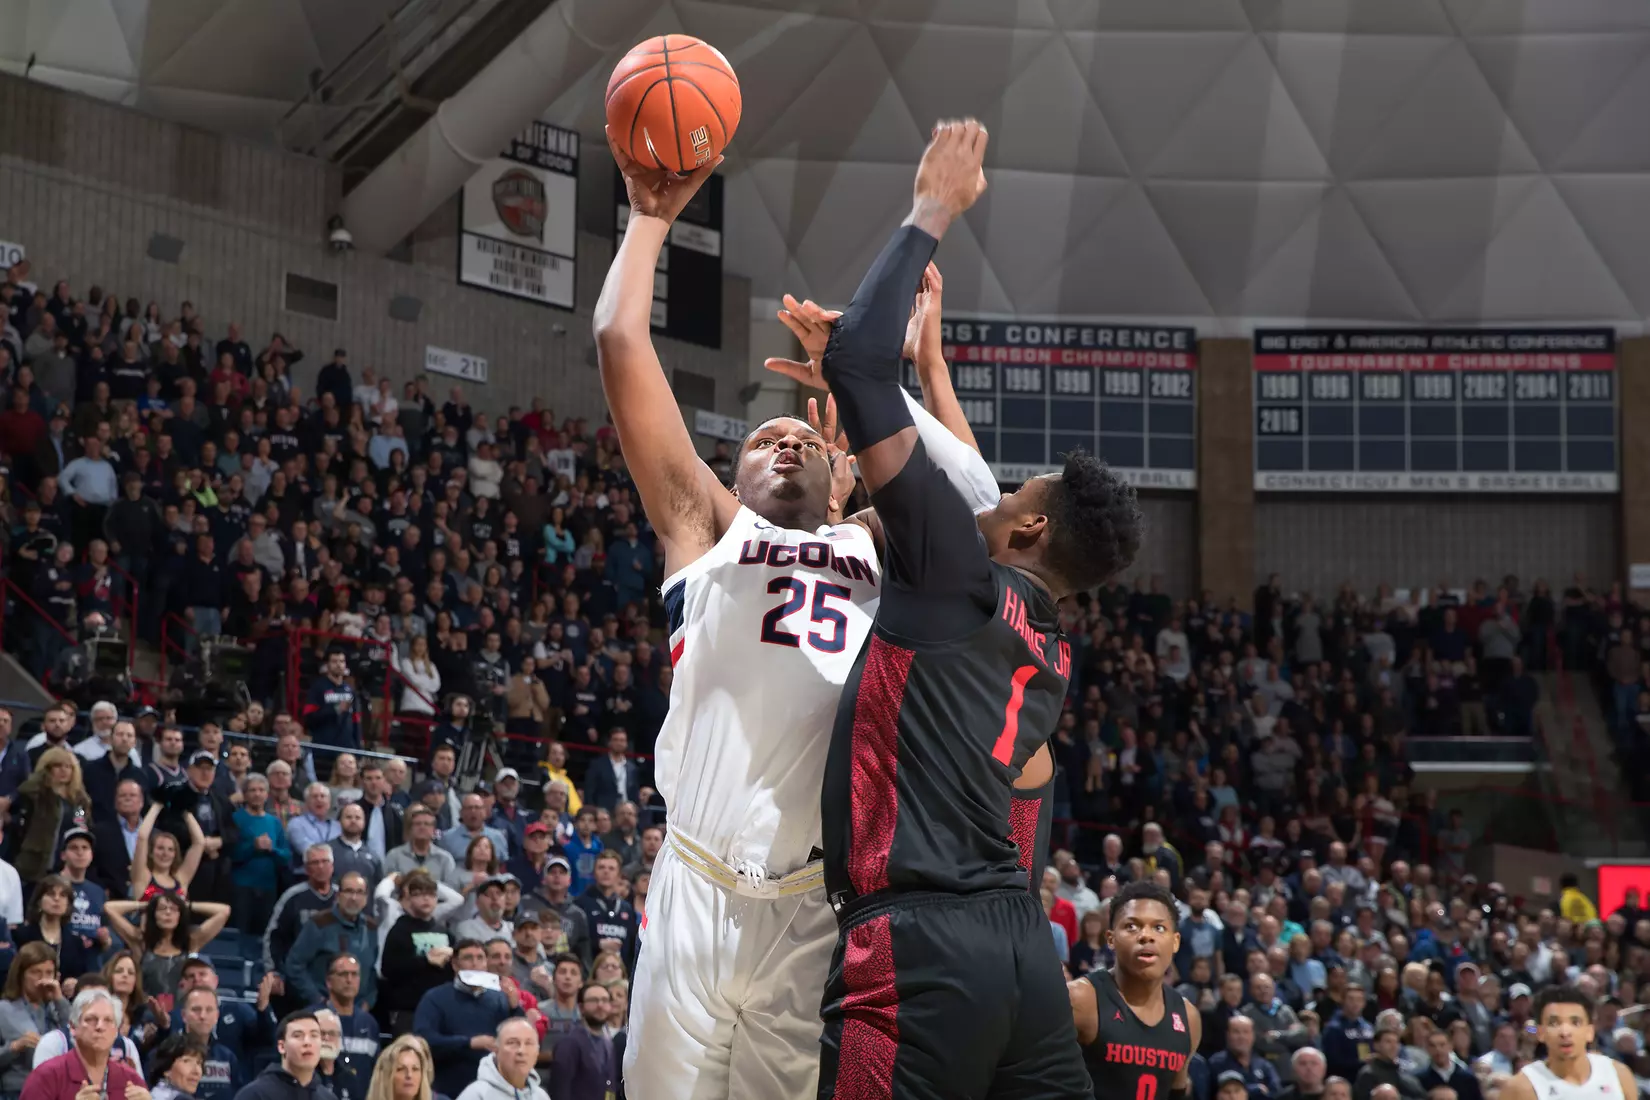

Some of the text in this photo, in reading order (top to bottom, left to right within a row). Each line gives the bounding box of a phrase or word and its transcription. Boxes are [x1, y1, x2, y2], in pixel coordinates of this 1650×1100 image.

[941, 323, 1187, 349] AST CONFERENCE
[1261, 336, 1287, 349] BIG
[1290, 336, 1328, 349] EAST
[1350, 336, 1429, 349] AMERICAN
[1432, 336, 1505, 349] ATHLETIC
[1508, 335, 1607, 349] CONFERENCE
[967, 345, 1051, 363] SEASON
[1061, 349, 1188, 368] CHAMPIONS
[1288, 354, 1582, 370] TOURNAMENT CHAMPIONS
[1260, 408, 1299, 432] 2016
[1264, 474, 1400, 489] CONNECTICUT
[1478, 475, 1607, 489] BASKETBALL
[738, 540, 876, 587] UCONN
[760, 576, 852, 653] 25
[991, 665, 1039, 767] 1
[1105, 1042, 1188, 1072] HOUSTON
[1136, 1073, 1158, 1100] 0
